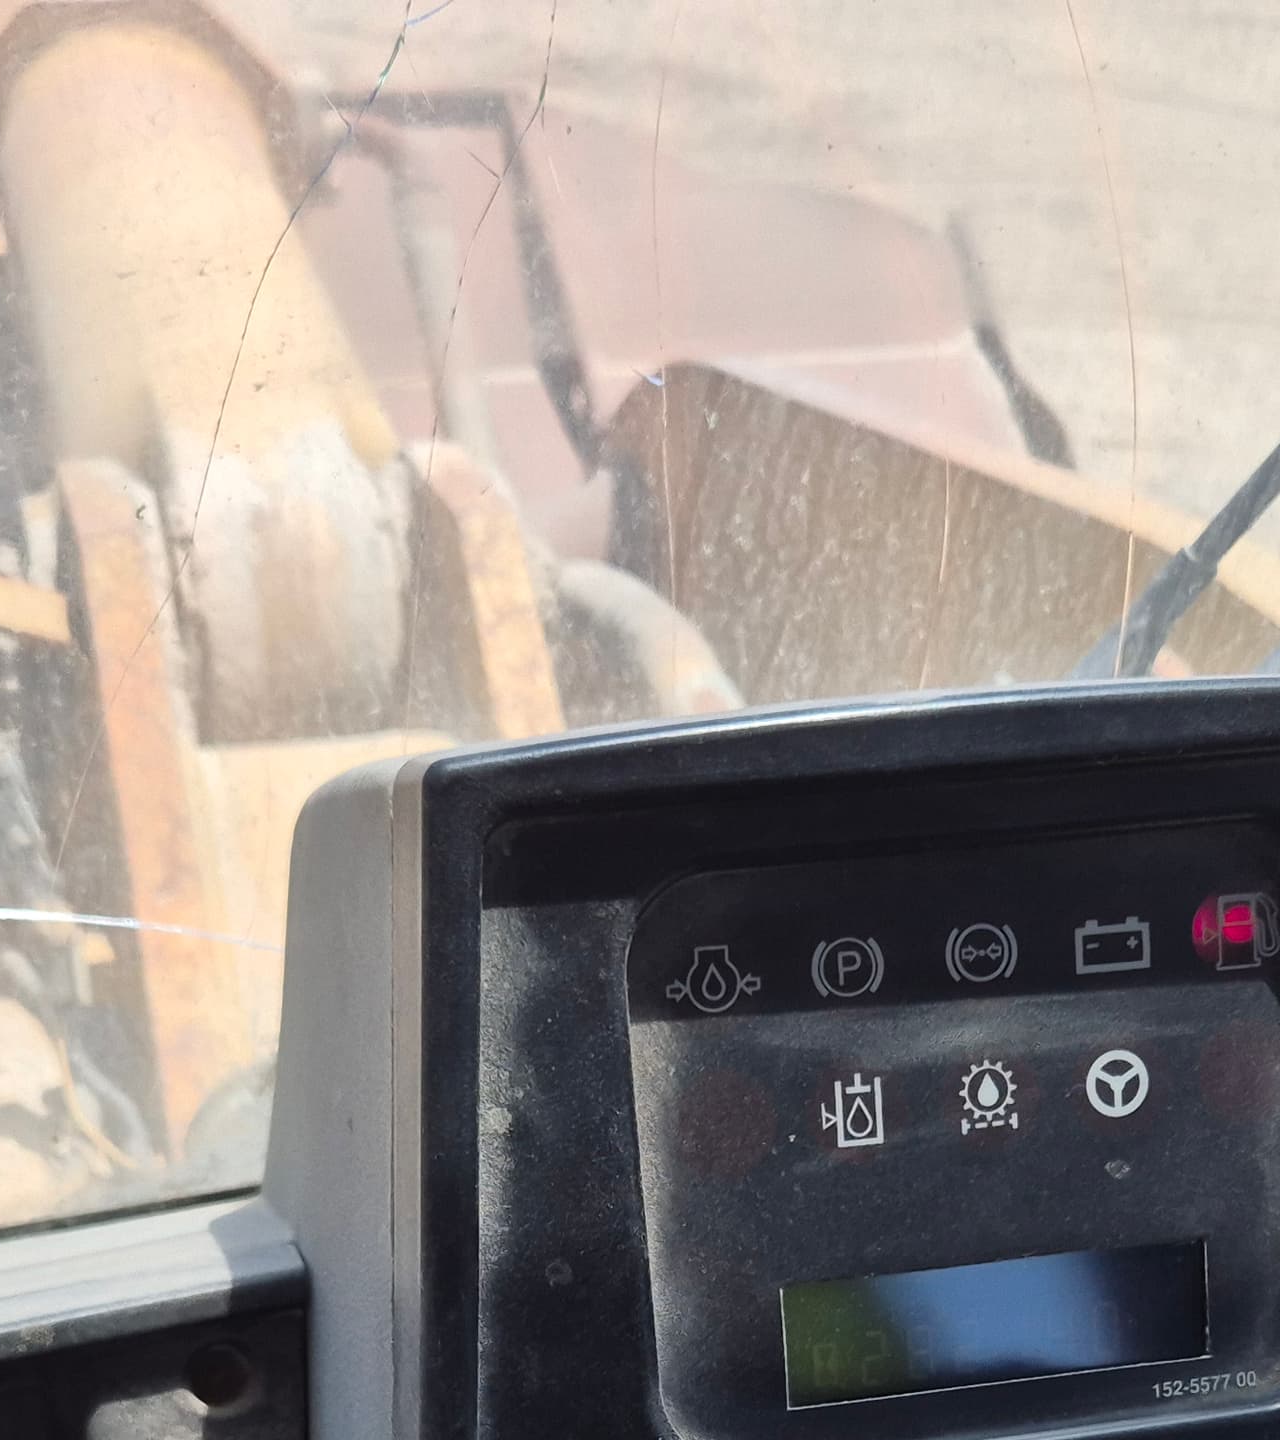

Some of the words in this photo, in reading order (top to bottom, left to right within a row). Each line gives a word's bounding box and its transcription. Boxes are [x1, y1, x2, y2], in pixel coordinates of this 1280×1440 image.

[837, 950, 862, 986] P
[1151, 1373, 1231, 1399] 152-5577
[1236, 1370, 1257, 1388] 00
